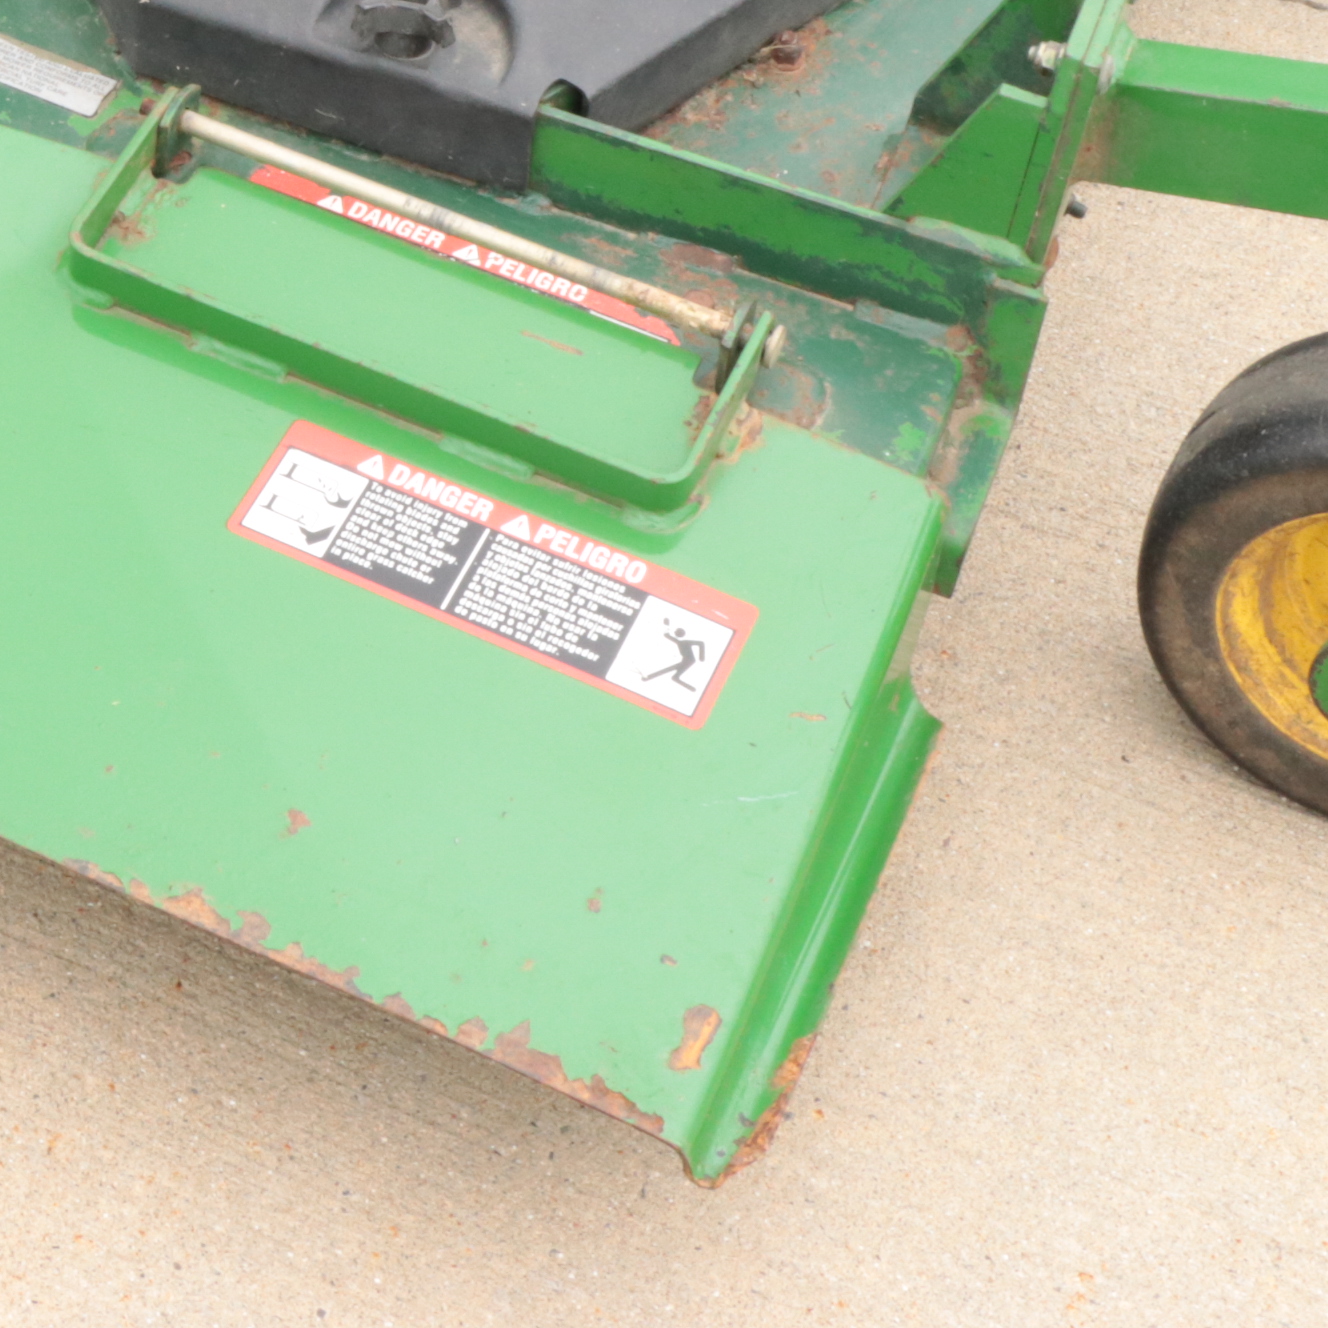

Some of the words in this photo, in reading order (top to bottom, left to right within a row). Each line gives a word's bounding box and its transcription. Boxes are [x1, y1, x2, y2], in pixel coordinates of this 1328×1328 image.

[346, 200, 446, 250] DANGER
[360, 498, 394, 517] thrown
[437, 531, 459, 545] stay
[364, 491, 404, 513] rotating
[405, 507, 438, 526] blades
[440, 522, 460, 535] and
[371, 481, 383, 493] To
[384, 489, 413, 505] avoid
[413, 500, 443, 519] injury
[444, 513, 468, 528] from
[388, 464, 494, 521] DANGER
[533, 523, 647, 584] PELIGRO
[345, 521, 360, 533] Do
[361, 529, 379, 541] not
[379, 537, 403, 551] mow
[405, 547, 442, 567] without
[350, 515, 370, 527] and
[370, 522, 395, 538] keep
[396, 534, 428, 552] others
[355, 507, 381, 521] clear
[382, 518, 395, 527] of
[395, 523, 418, 537] deck
[420, 534, 445, 548] edge
[330, 545, 342, 556] in
[335, 539, 365, 555] entire
[366, 552, 395, 568] grass
[396, 564, 434, 584] catcher
[340, 530, 388, 555] discharge
[390, 551, 418, 568] chute
[419, 564, 432, 573] or
